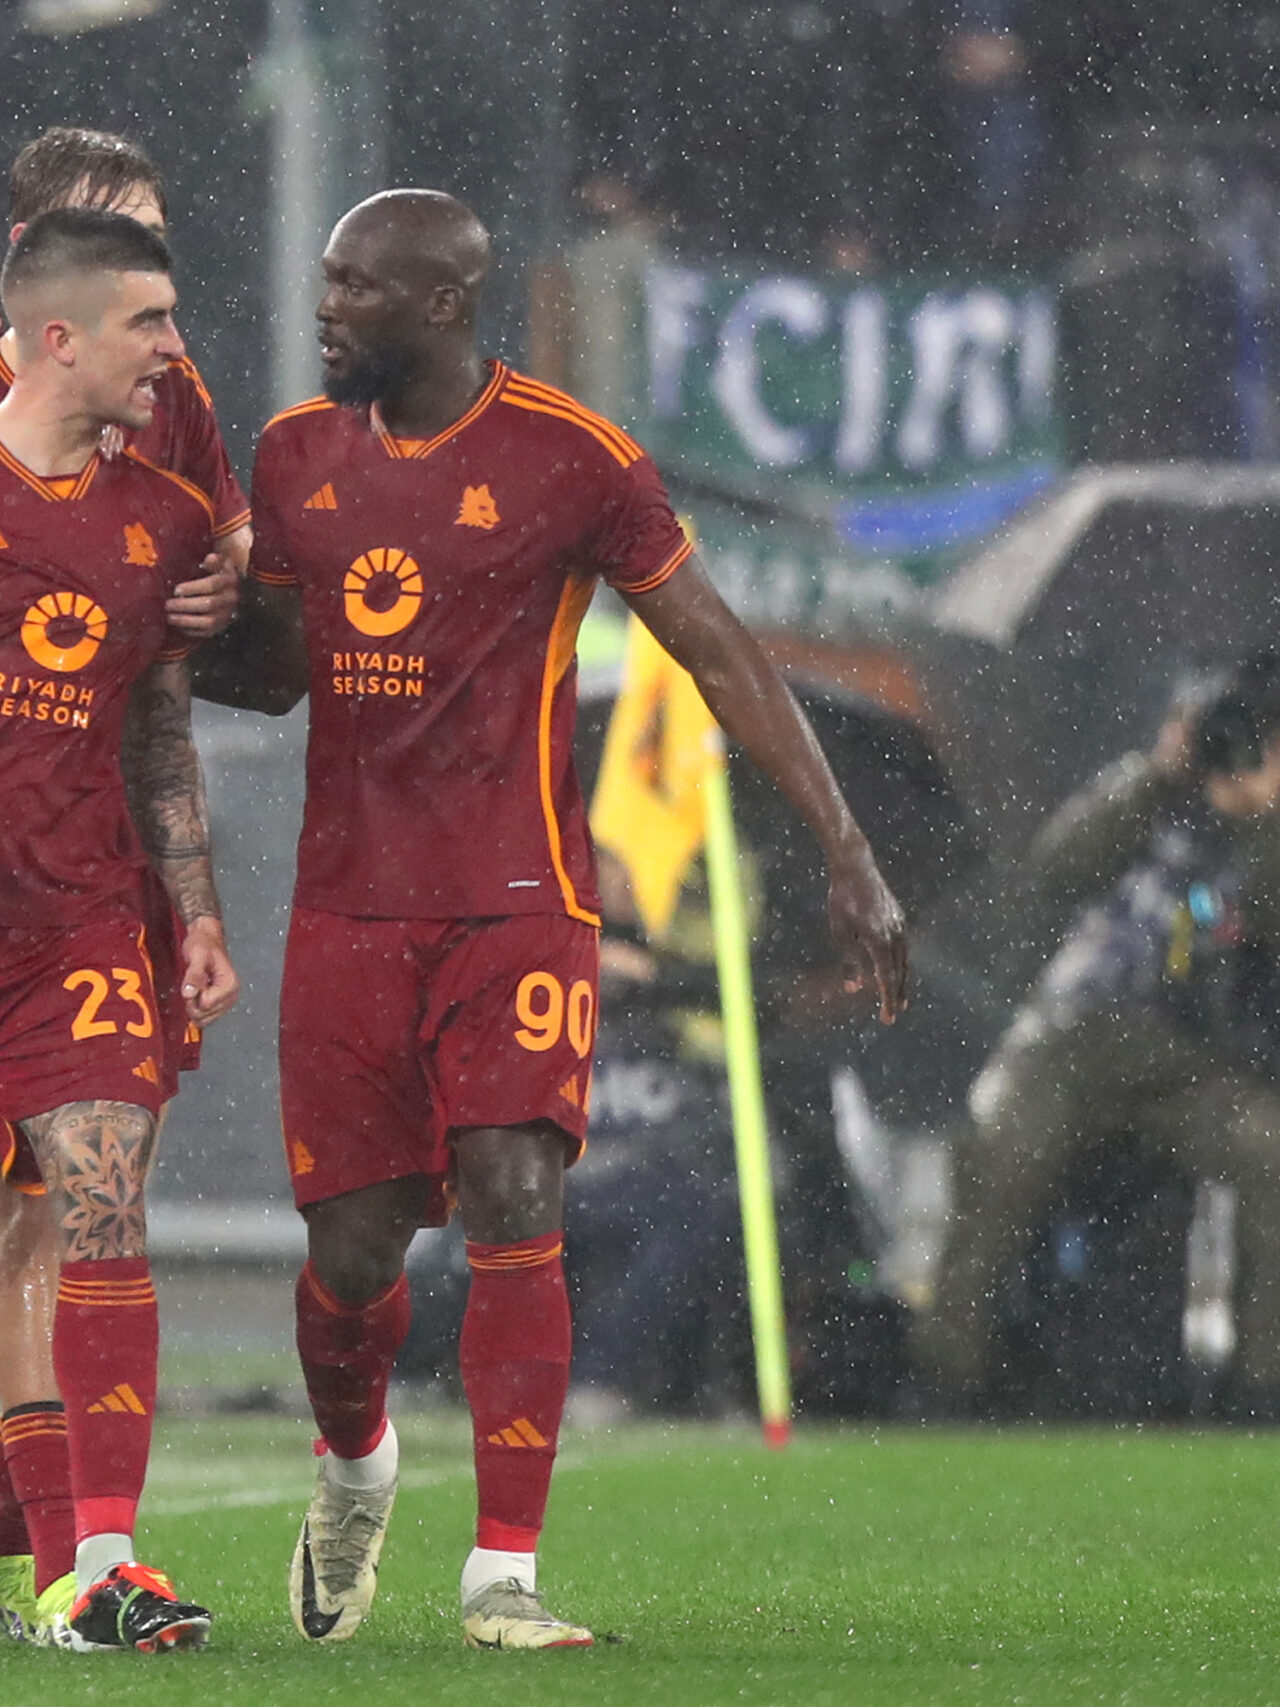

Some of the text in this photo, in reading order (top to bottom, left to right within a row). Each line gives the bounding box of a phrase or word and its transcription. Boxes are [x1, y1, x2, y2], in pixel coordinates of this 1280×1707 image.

[331, 652, 425, 674] RIYADH
[333, 675, 424, 697] SEASON
[62, 967, 154, 1041] 23
[514, 971, 594, 1060] 90
